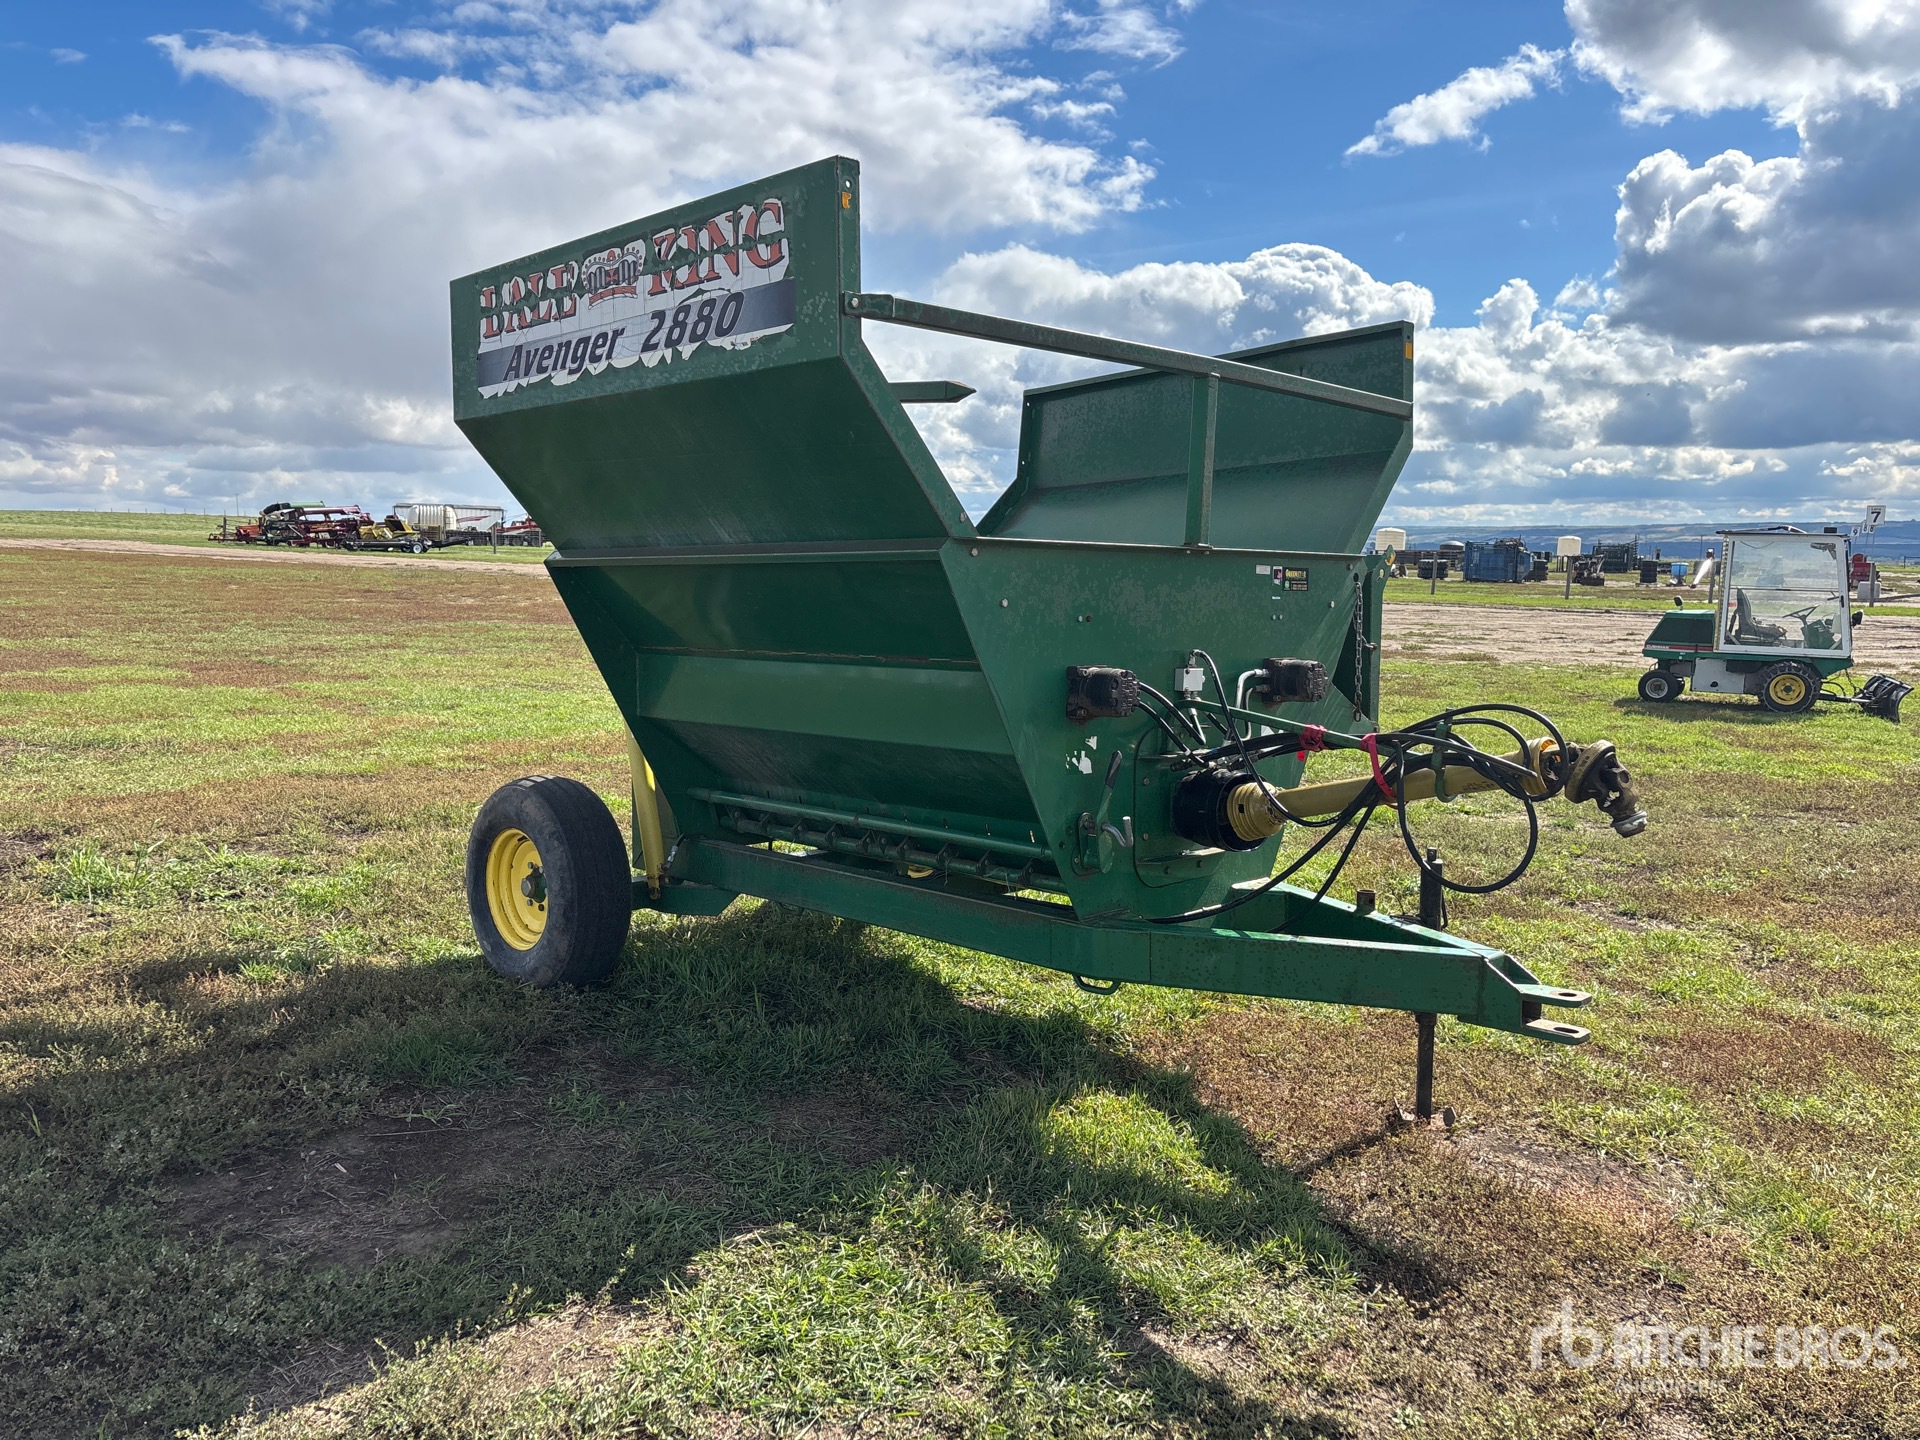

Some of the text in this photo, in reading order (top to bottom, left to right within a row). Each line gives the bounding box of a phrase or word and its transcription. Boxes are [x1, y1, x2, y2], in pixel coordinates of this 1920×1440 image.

[503, 292, 744, 382] Avenger 2880
[1870, 511, 1881, 523] 7
